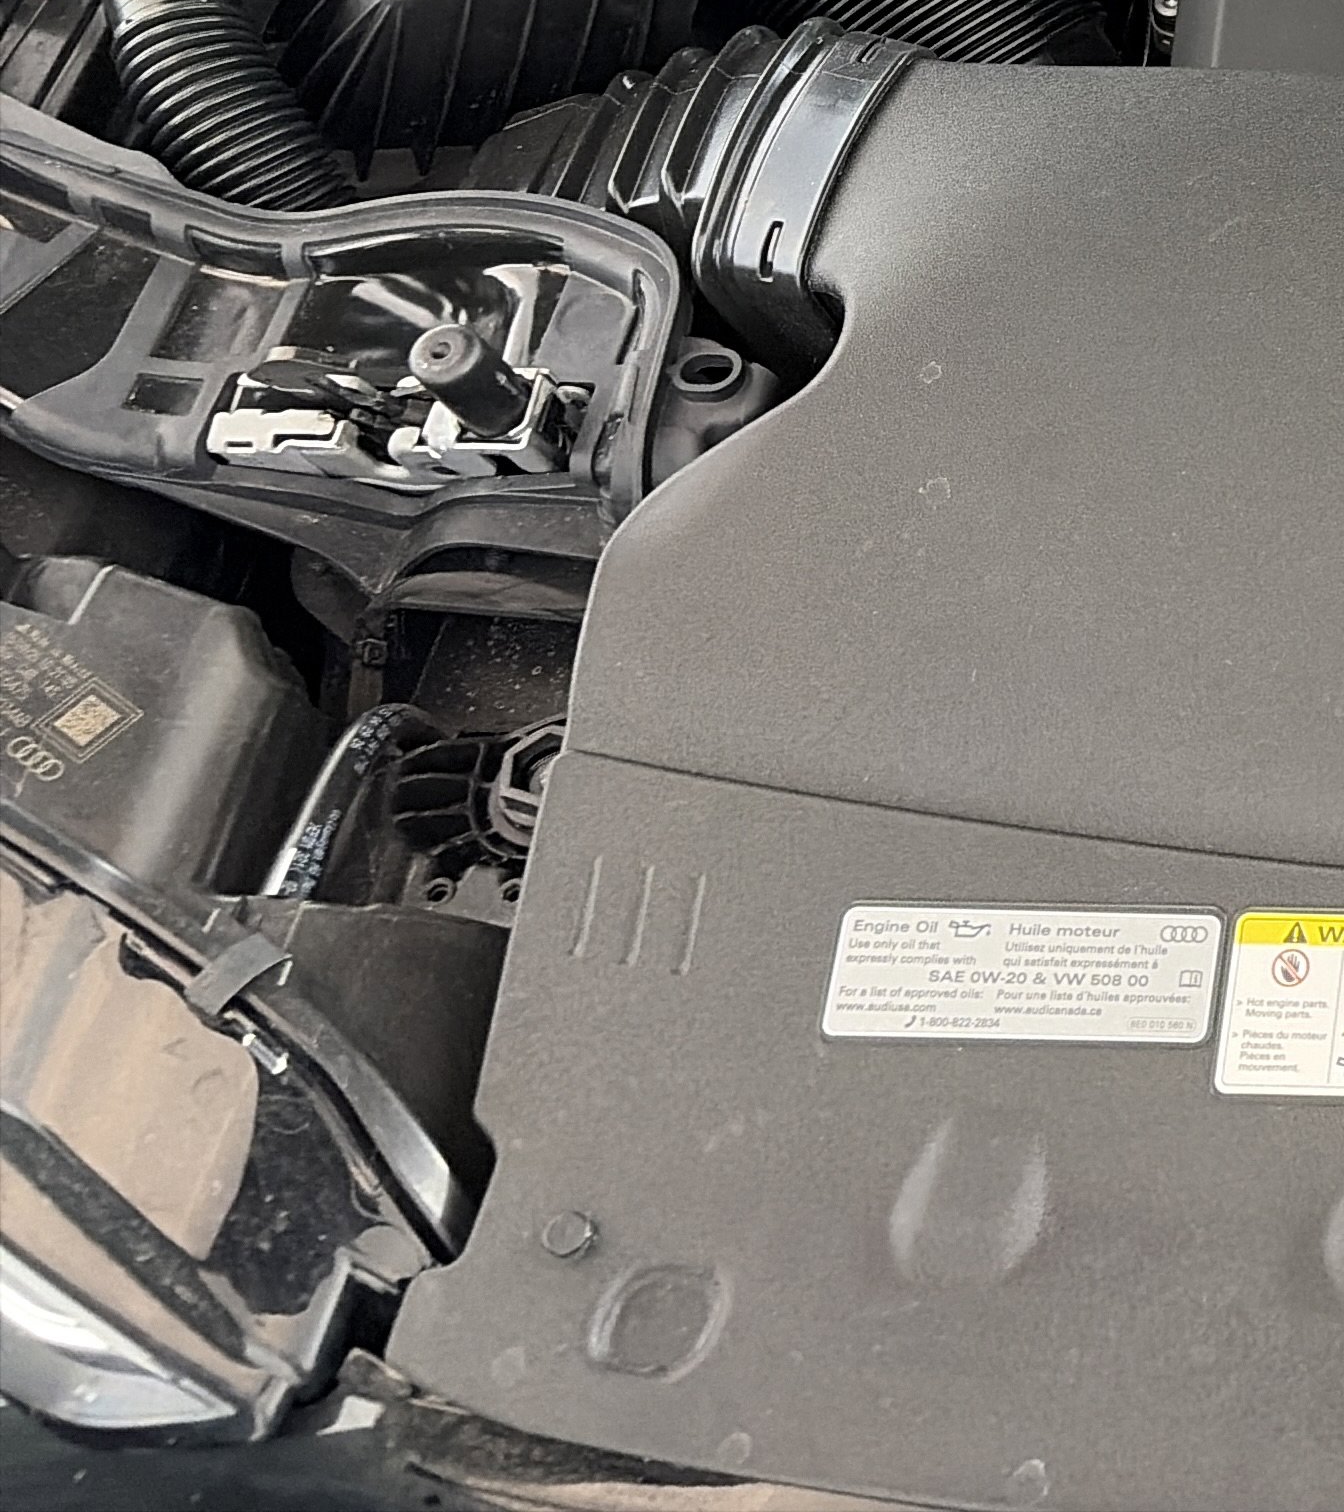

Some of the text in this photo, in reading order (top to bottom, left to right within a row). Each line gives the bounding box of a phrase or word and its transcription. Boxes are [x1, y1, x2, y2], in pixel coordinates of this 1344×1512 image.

[853, 920, 939, 934] Engine Oil
[1009, 923, 1120, 937] Huile moteur
[849, 939, 941, 950] Use only oil that
[1005, 942, 1045, 952] Utilisez
[1049, 943, 1114, 955] uniquement
[1118, 945, 1131, 954] de
[846, 954, 977, 965] expressly complies with
[1003, 957, 1021, 967] qui
[1024, 958, 1067, 967] satisfait
[928, 970, 1149, 986] SAE 0W-20 & VW 508 00
[839, 986, 857, 996] For
[870, 987, 887, 997] list
[890, 987, 900, 997] of
[904, 988, 957, 999] approved
[961, 989, 983, 999] oils:
[997, 990, 1023, 999] Pour
[1026, 992, 1047, 1000] une
[1050, 992, 1074, 1001] liste
[836, 1002, 936, 1012] www.audiusa.com
[1247, 998, 1264, 1006] Hot
[1267, 1000, 1300, 1008] engine
[994, 1006, 1102, 1016] www.audicanada.ca
[1245, 1009, 1282, 1019] Moving
[1276, 1031, 1289, 1039] du
[1291, 1032, 1327, 1040] moteur
